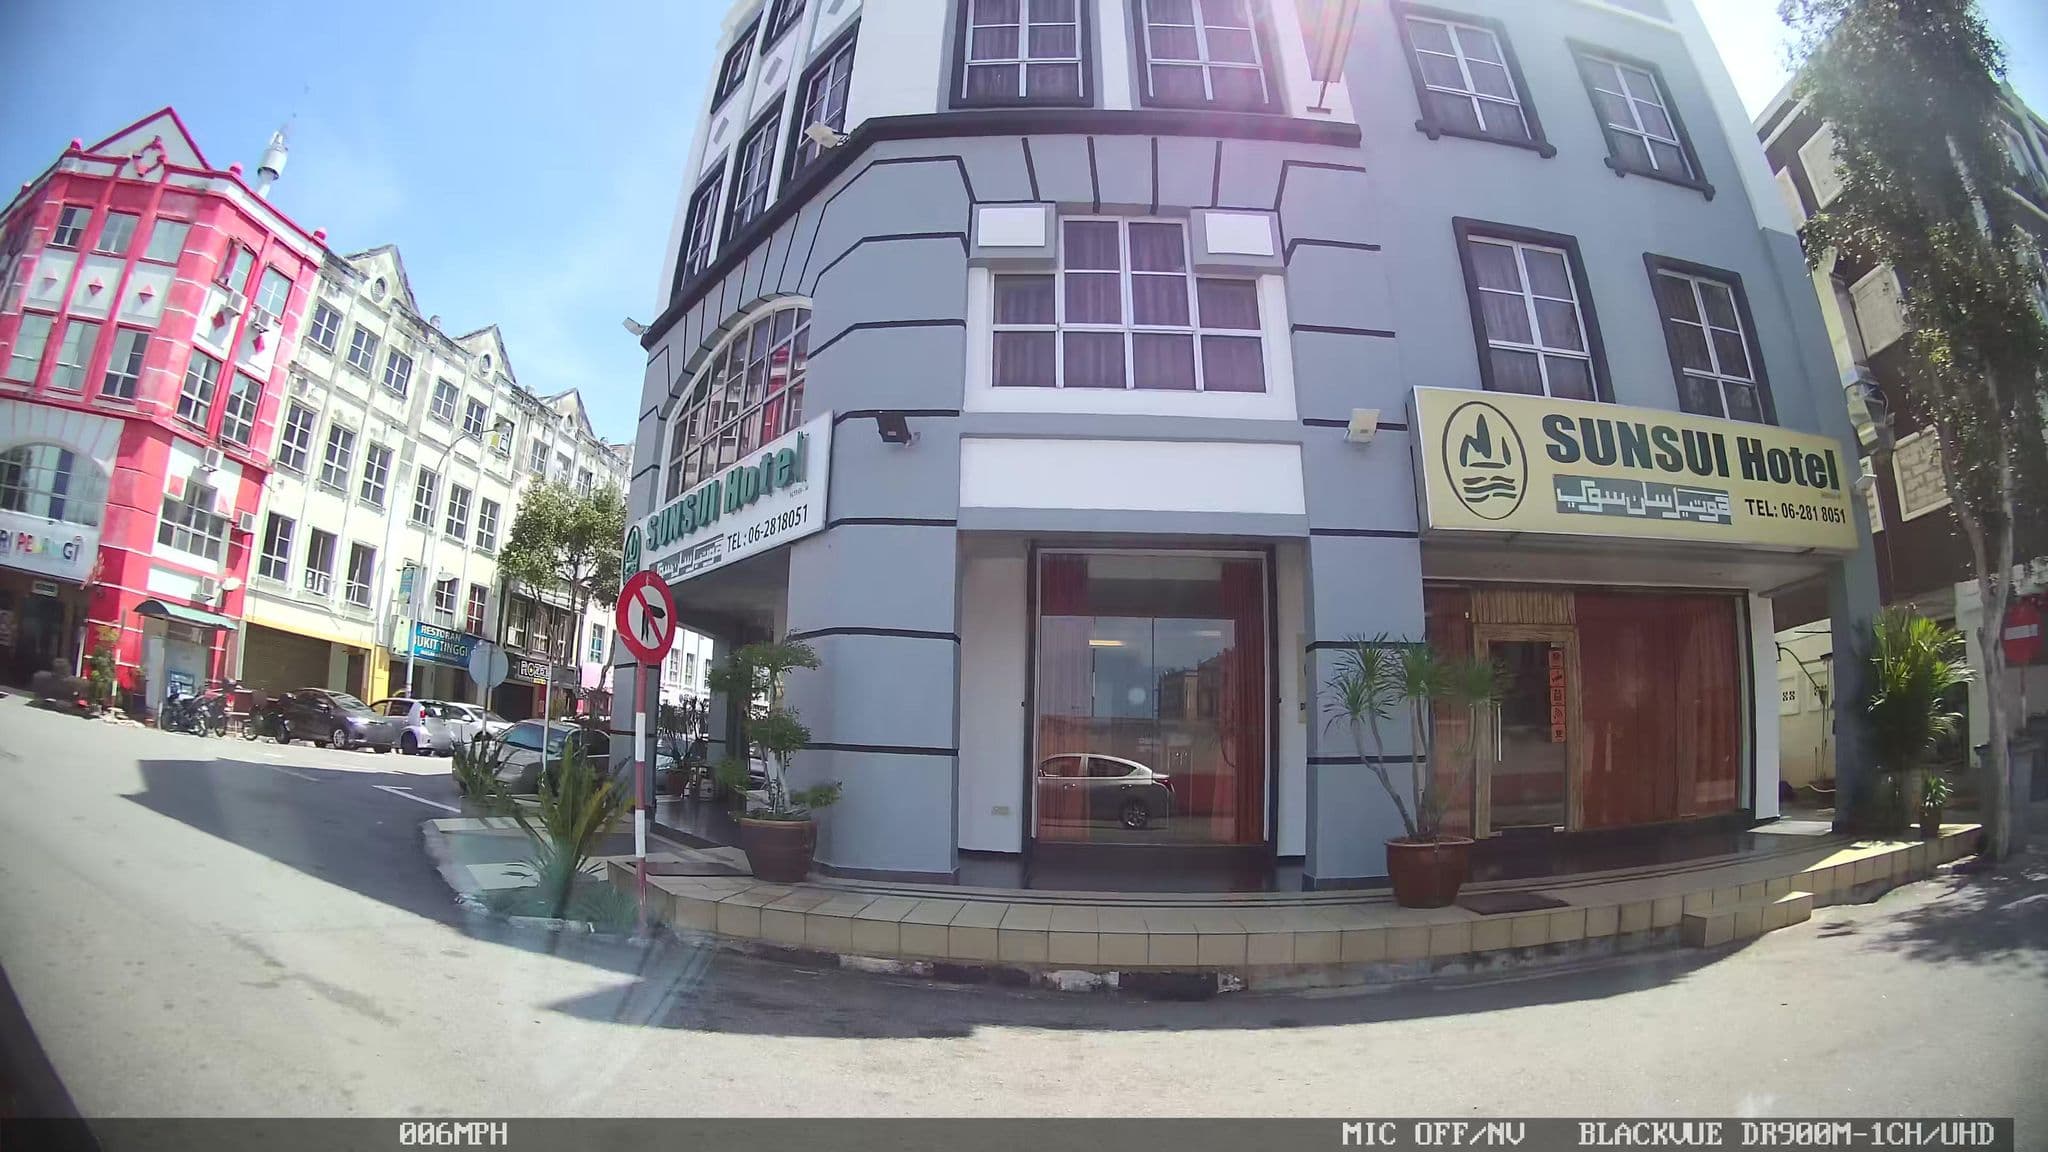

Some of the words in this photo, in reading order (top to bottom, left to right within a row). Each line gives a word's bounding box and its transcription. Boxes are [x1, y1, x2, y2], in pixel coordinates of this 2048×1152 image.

[1542, 414, 1730, 478] SUNSUI
[1736, 436, 1840, 490] Hotel
[645, 480, 720, 551] SUNSUI
[723, 431, 809, 515] Hotel
[748, 504, 809, 545] 06-2818051
[1744, 498, 1778, 518] TEL:
[1781, 502, 1818, 522] 06-281
[1821, 506, 1846, 524] 8051
[421, 625, 462, 642] RESTORAN
[439, 639, 469, 657] TINGGI
